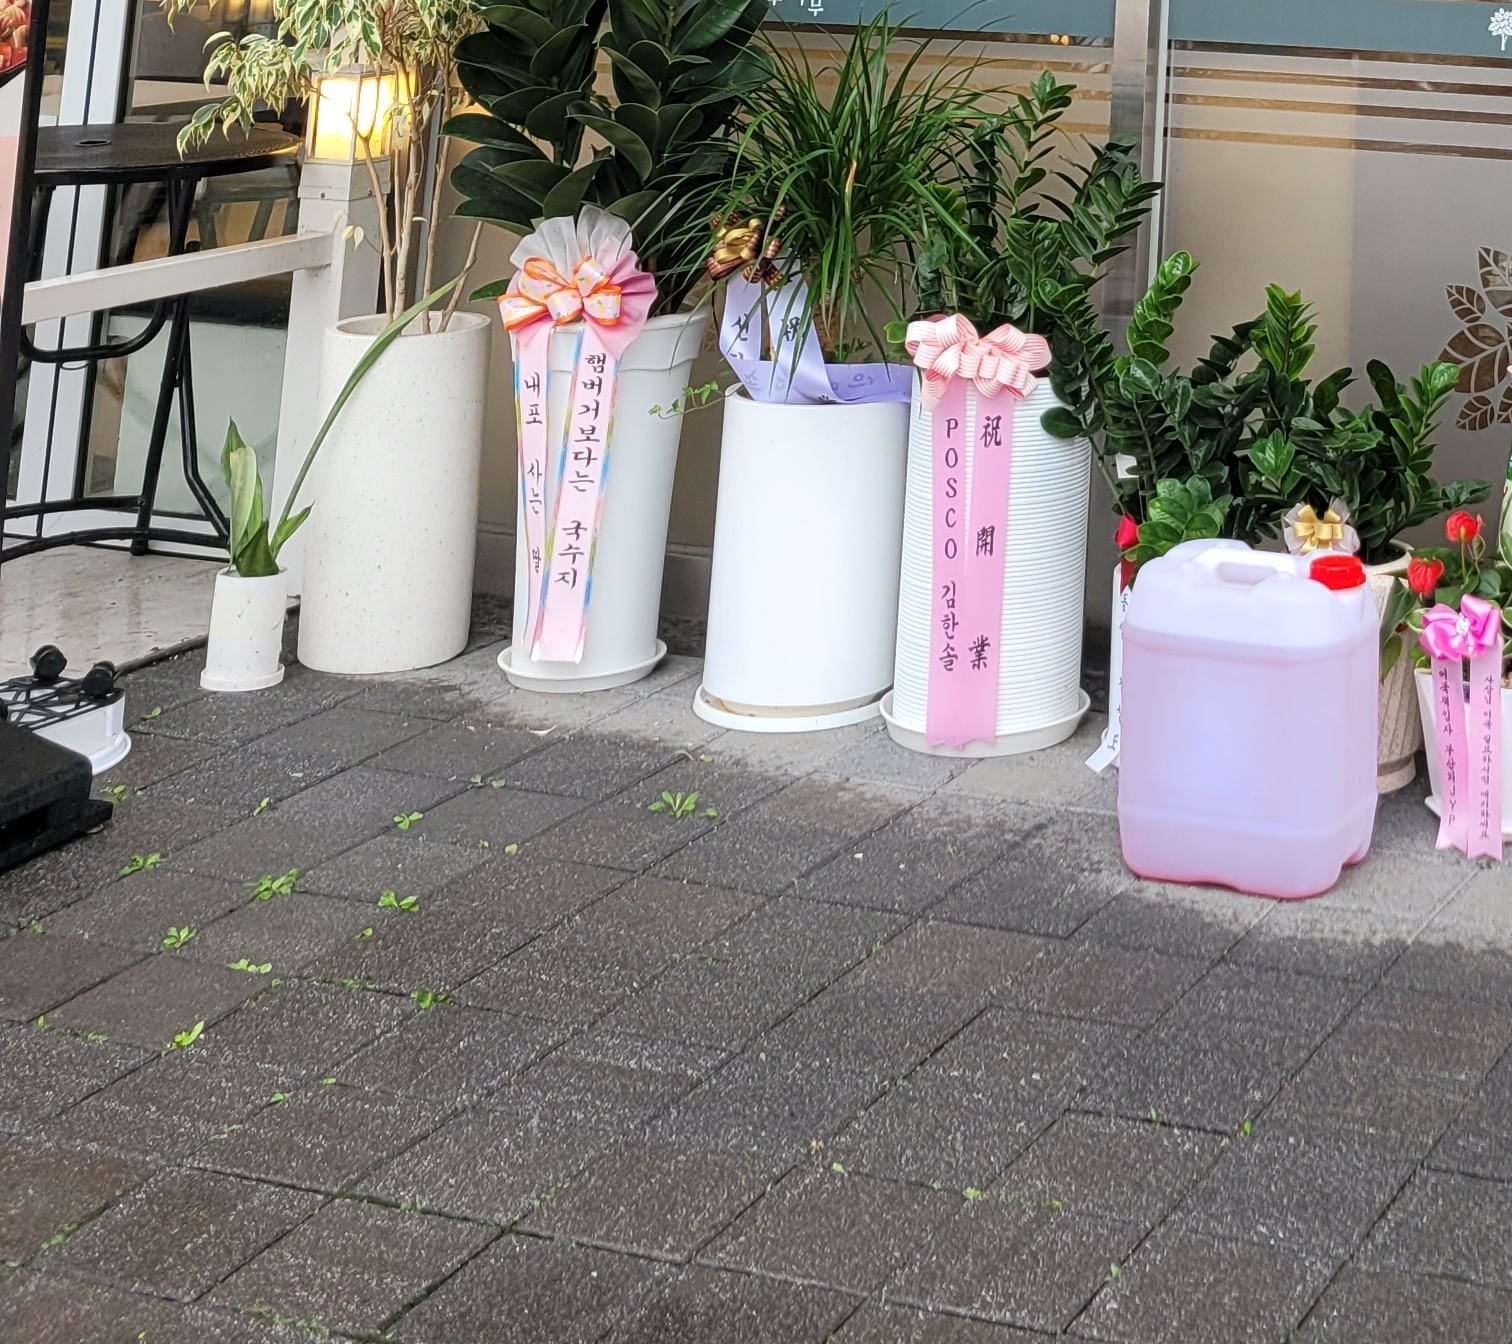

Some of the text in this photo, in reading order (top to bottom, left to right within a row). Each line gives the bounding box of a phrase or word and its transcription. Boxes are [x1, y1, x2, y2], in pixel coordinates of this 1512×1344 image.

[524, 371, 543, 426] 내포
[554, 352, 608, 591] 햄버거보다는 국수지
[526, 458, 543, 515] 사는
[938, 417, 960, 673] POSCO 김한솔
